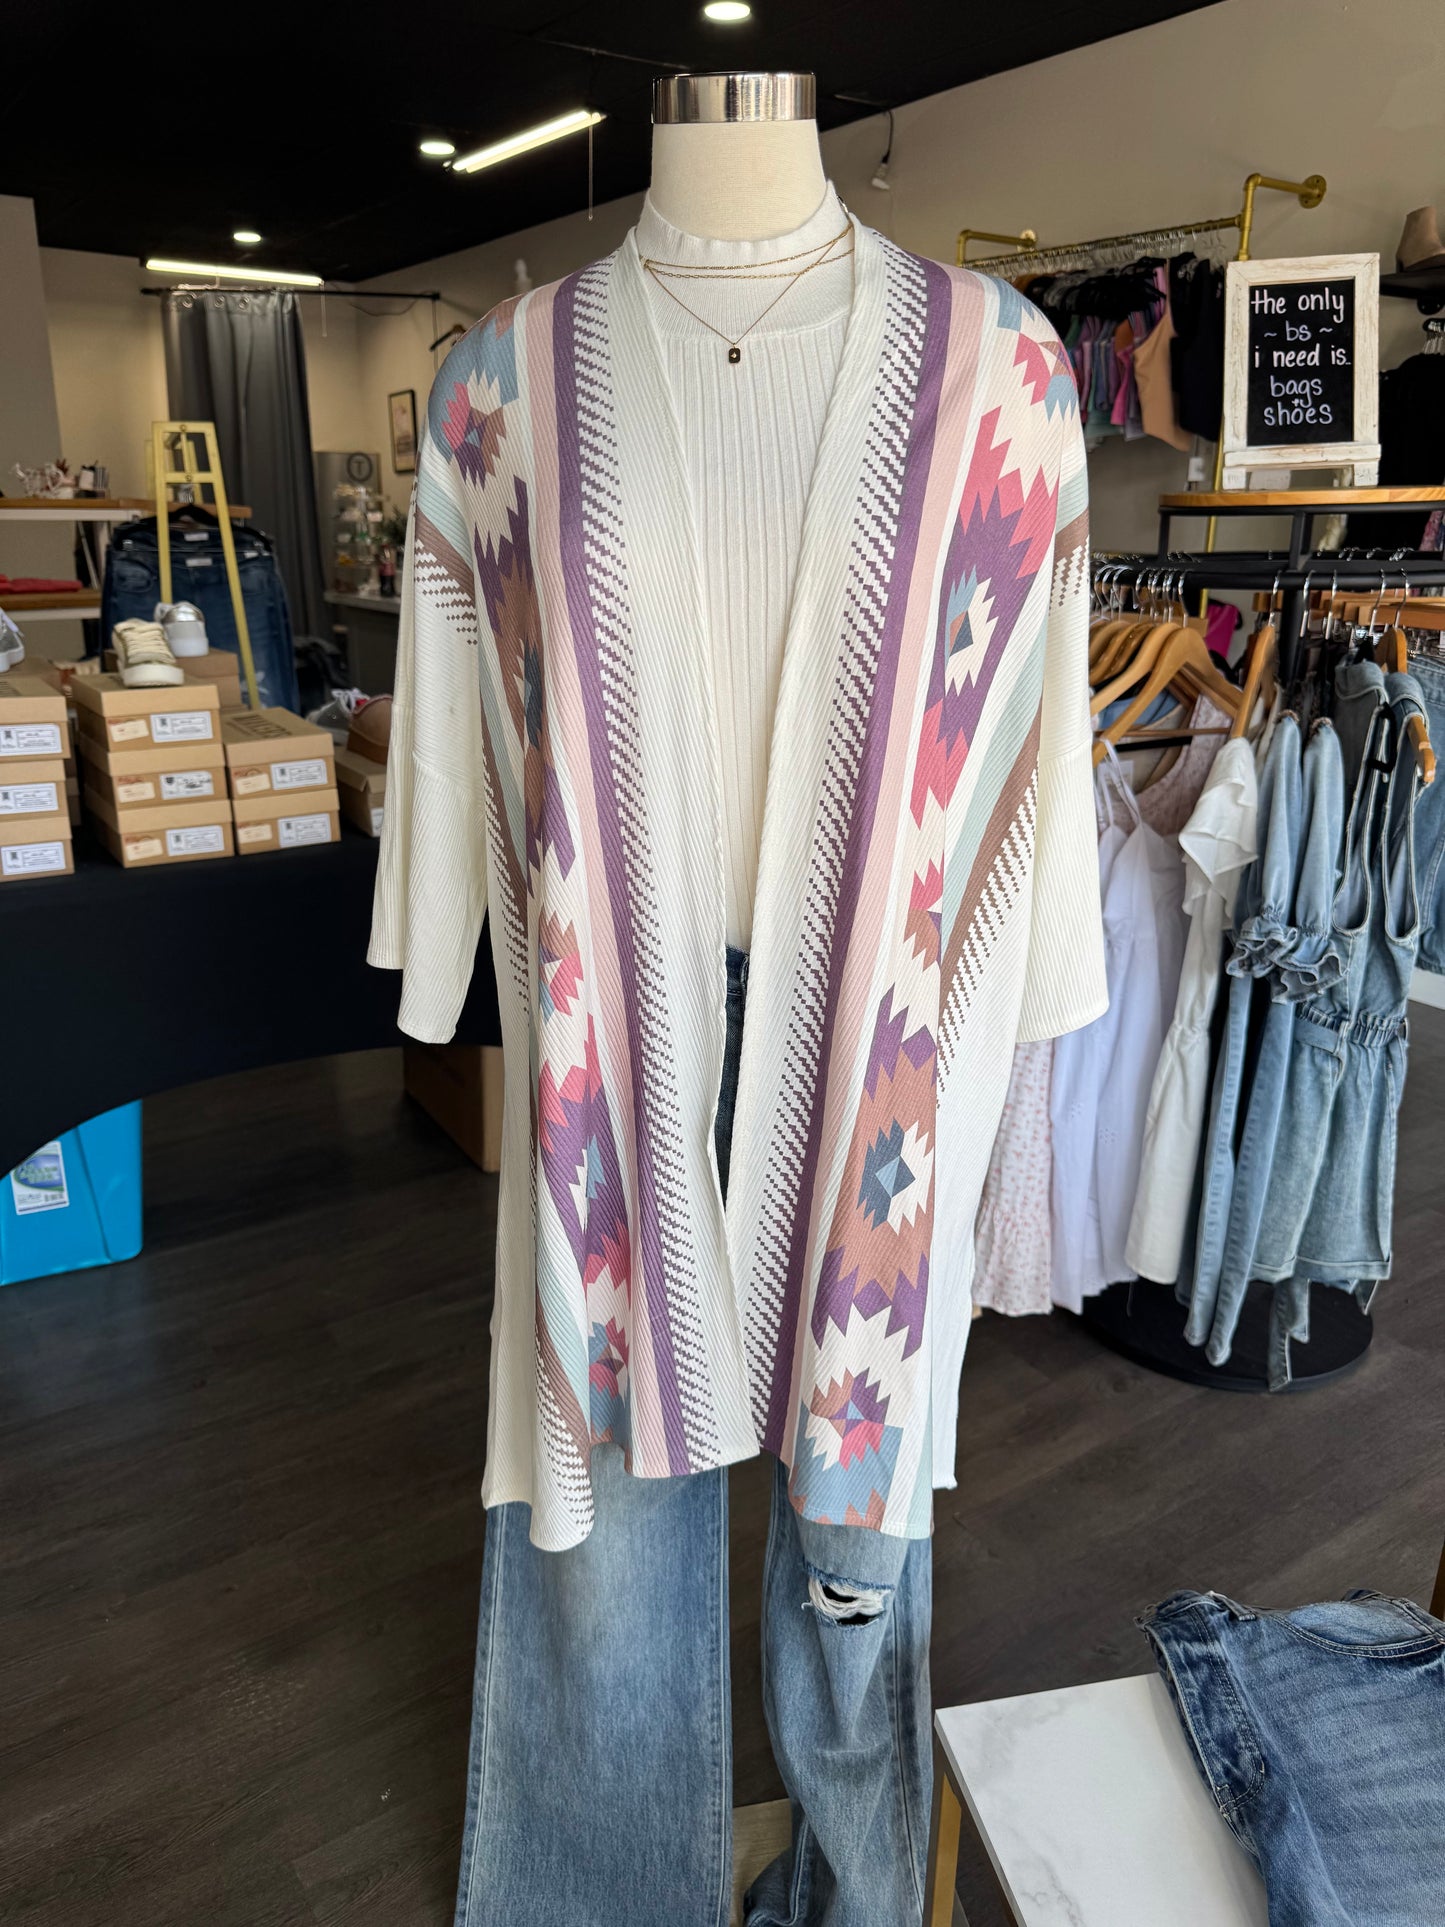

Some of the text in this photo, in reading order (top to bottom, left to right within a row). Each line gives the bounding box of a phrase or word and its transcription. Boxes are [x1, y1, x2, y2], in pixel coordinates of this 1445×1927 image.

[1251, 287, 1344, 323] the only
[1286, 320, 1312, 342] bs
[1255, 346, 1260, 368] i
[1272, 343, 1320, 367] need
[1270, 375, 1323, 408] bags
[1264, 402, 1333, 426] shoes
